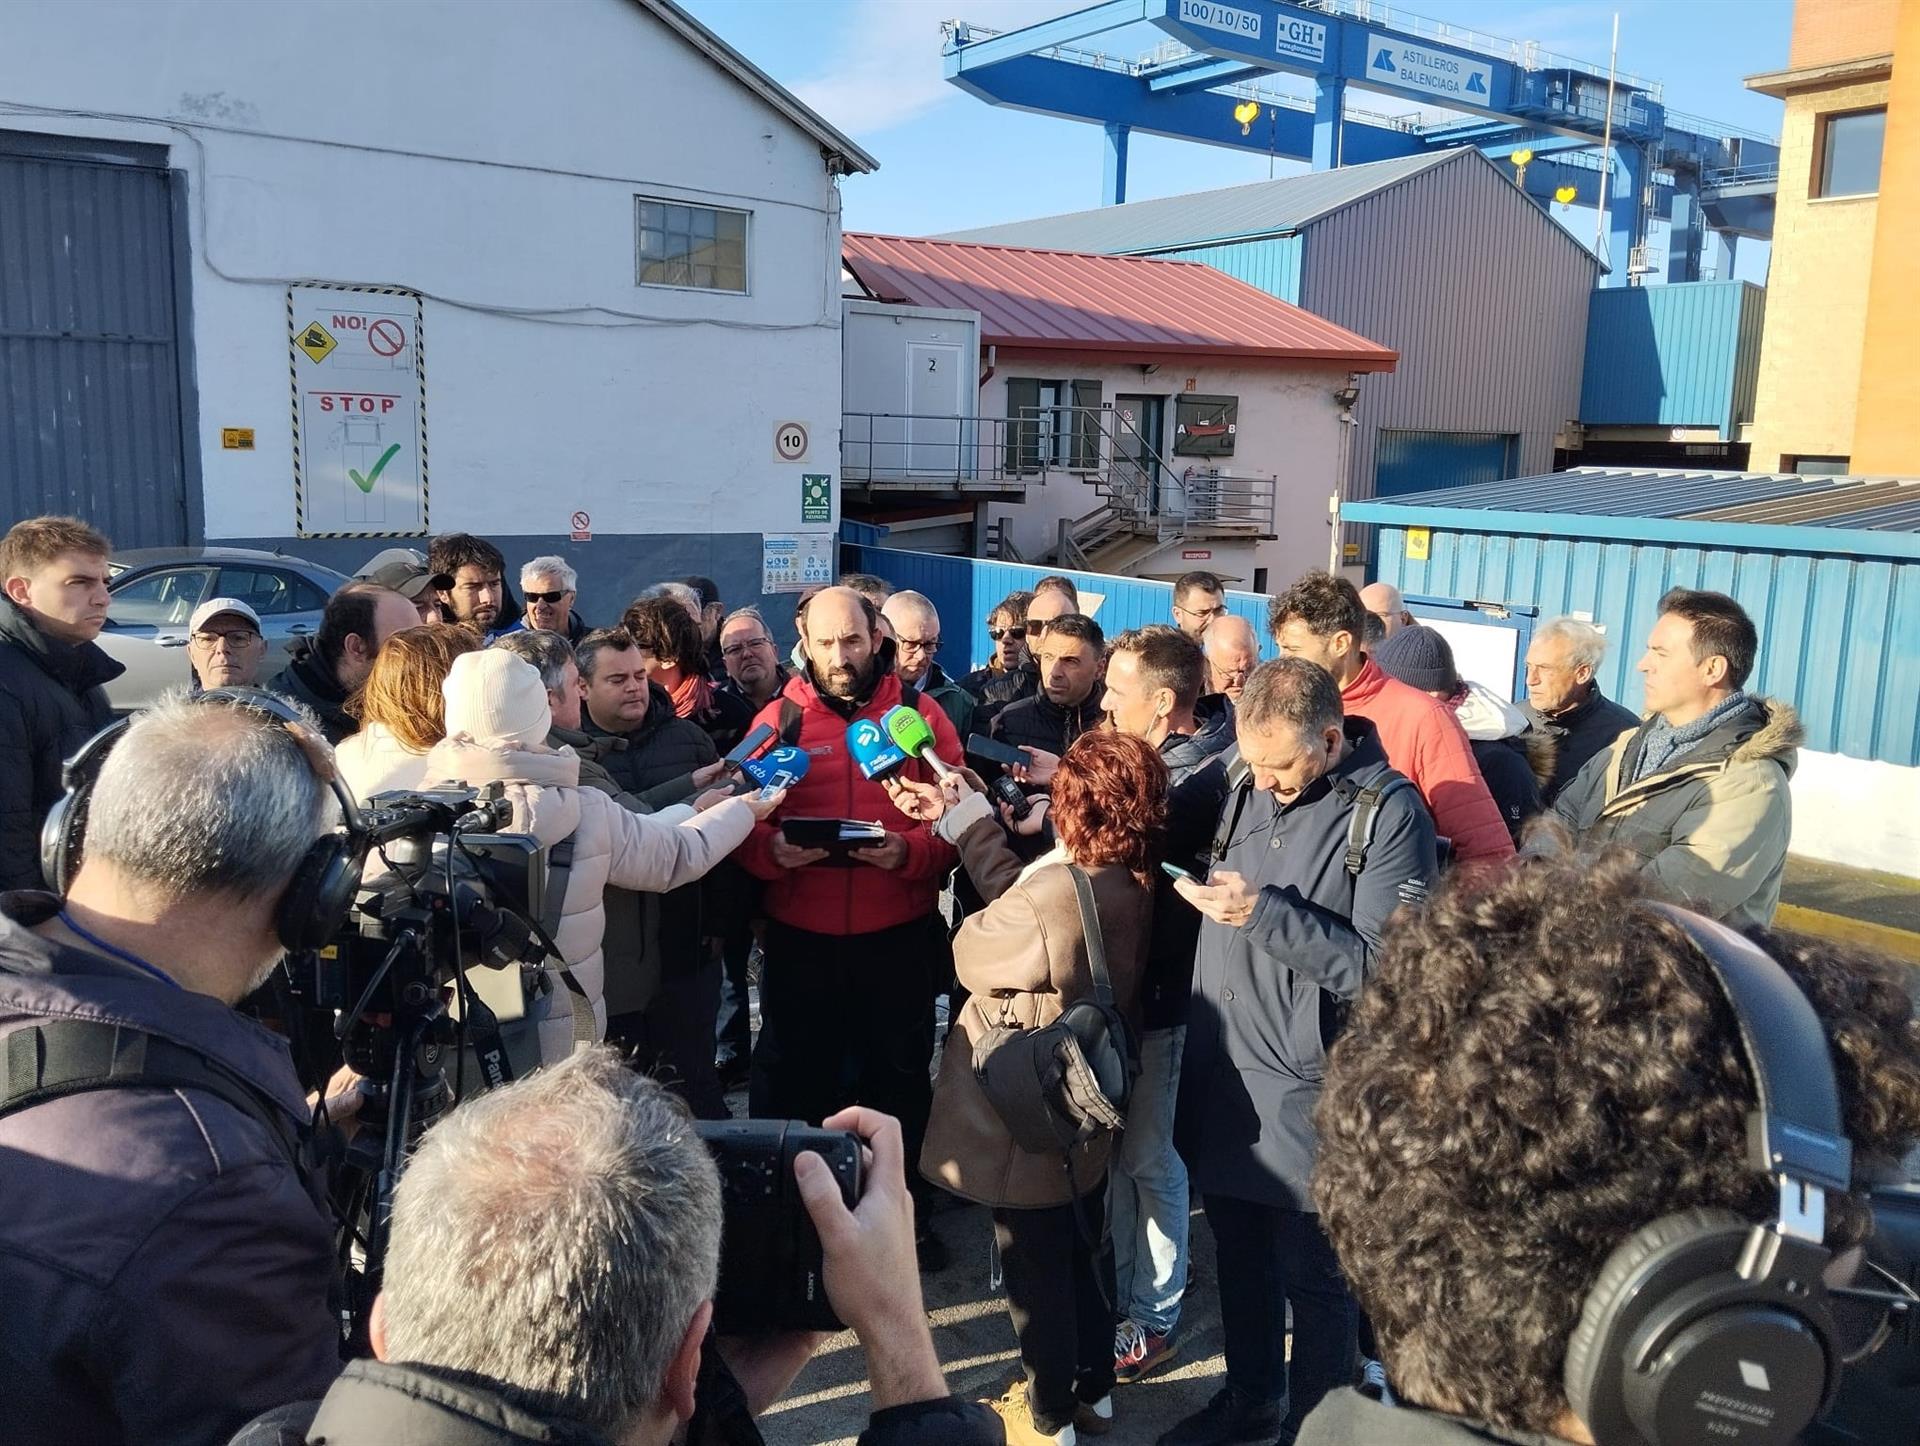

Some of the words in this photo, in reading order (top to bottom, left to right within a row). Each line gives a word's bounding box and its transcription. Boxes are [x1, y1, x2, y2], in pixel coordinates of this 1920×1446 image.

[1183, 1, 1258, 32] 100/10/50
[1289, 22, 1315, 44] GH
[1403, 49, 1459, 74] ASTILLEROS
[1400, 68, 1459, 93] BALENCIAGA
[332, 315, 368, 330] NO!
[928, 358, 937, 371] 2
[1177, 423, 1187, 434] A
[1228, 423, 1236, 434] B
[783, 435, 801, 448] 10
[748, 764, 766, 778] etb
[807, 1271, 815, 1301] SONY
